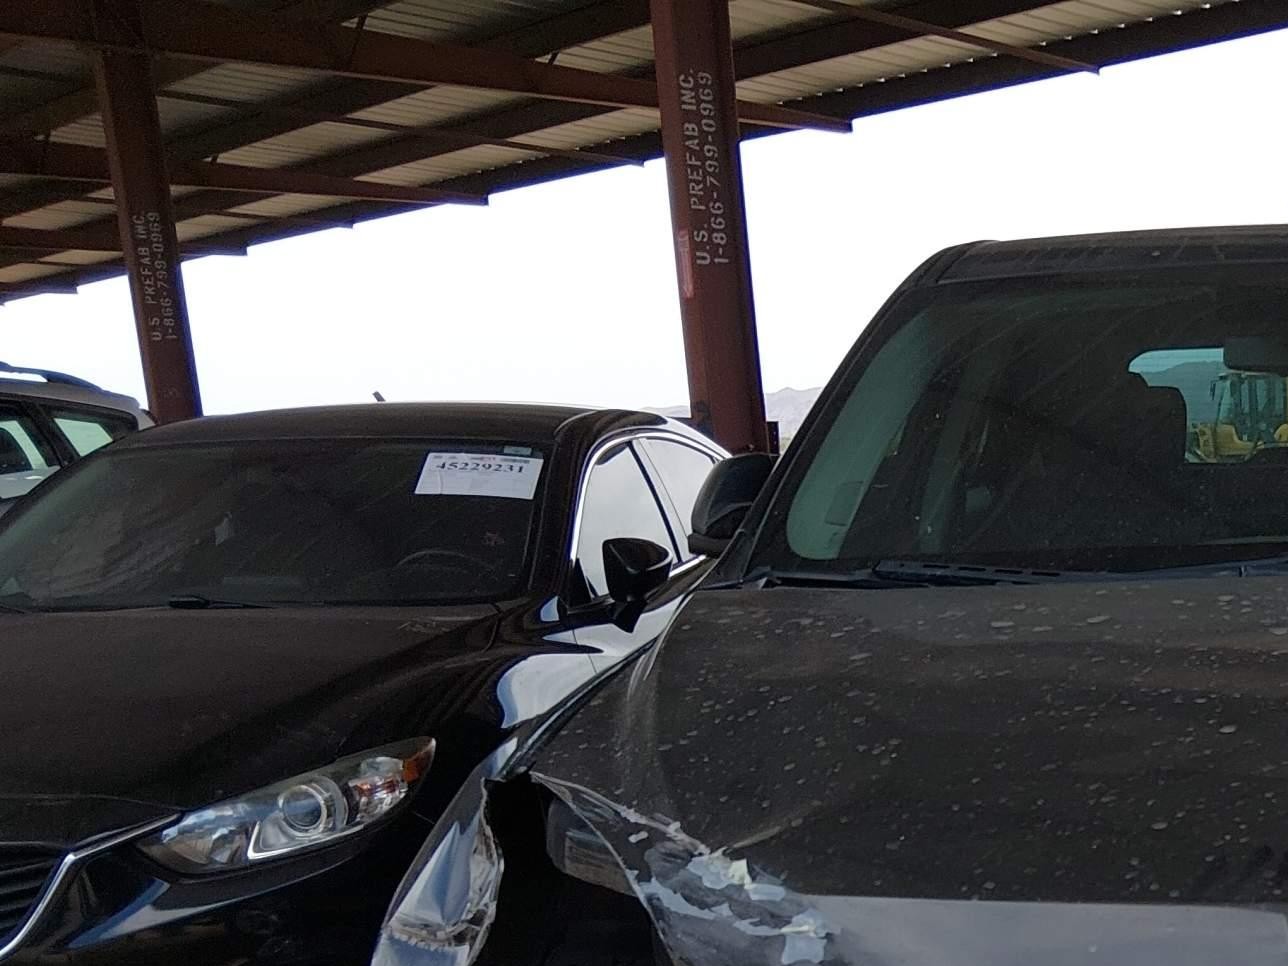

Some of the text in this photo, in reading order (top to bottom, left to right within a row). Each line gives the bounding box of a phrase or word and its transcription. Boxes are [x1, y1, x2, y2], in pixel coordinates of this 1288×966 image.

[679, 69, 711, 265] U.S. PREFAB INC.
[699, 72, 729, 264] 1-866-799-0969
[138, 247, 157, 304] PREFAB
[147, 212, 178, 339] 1-866-799-0969
[436, 461, 525, 474] 45229231
